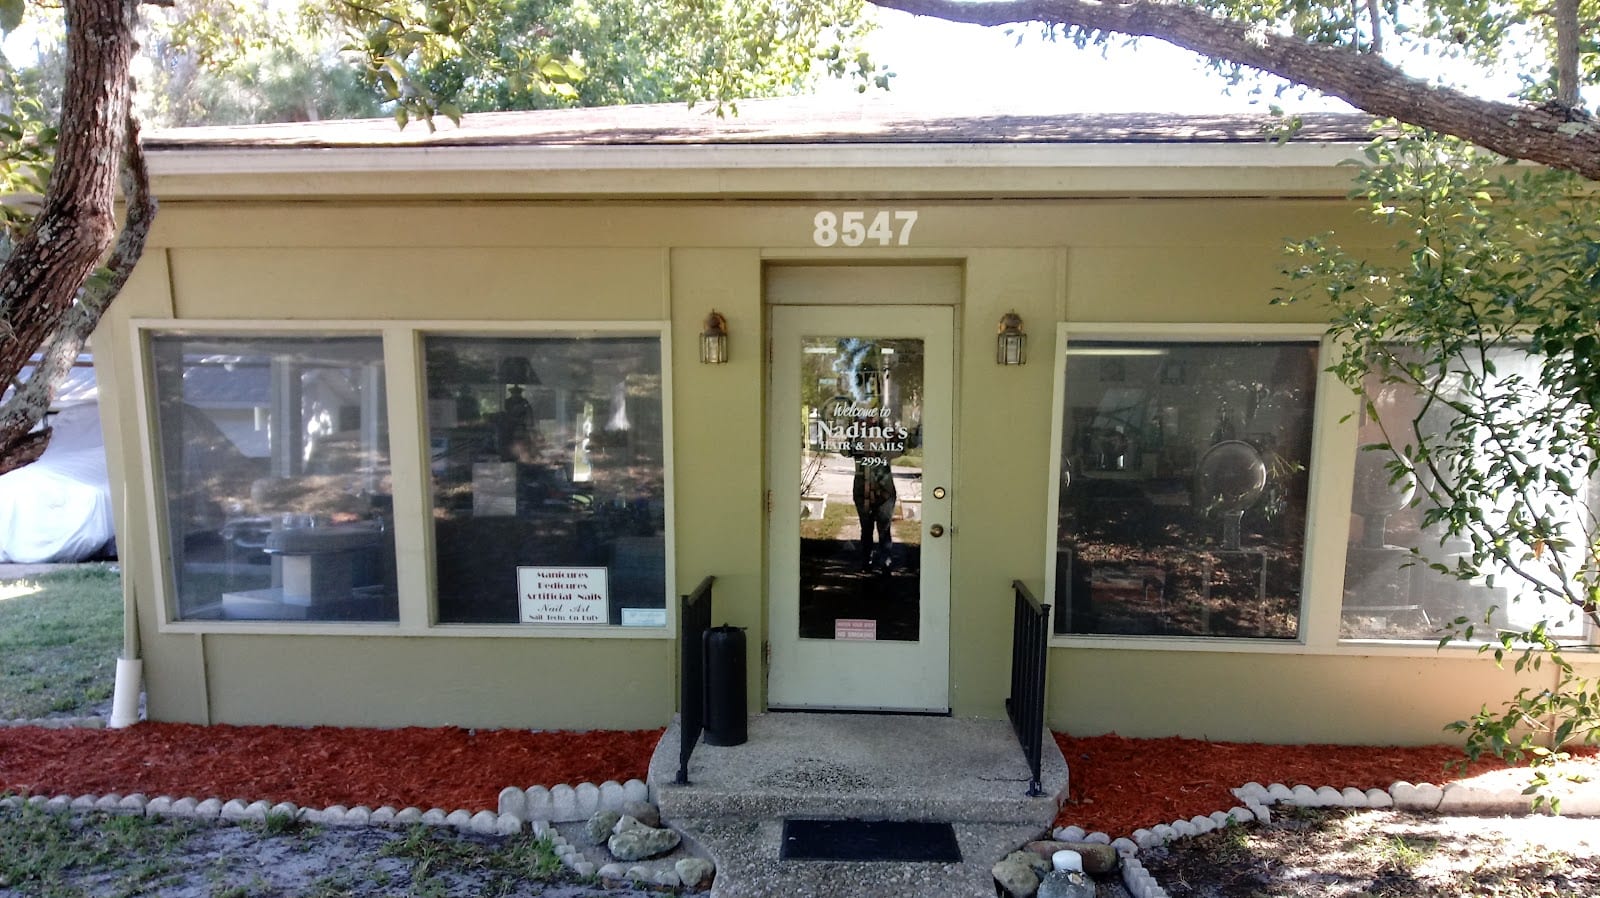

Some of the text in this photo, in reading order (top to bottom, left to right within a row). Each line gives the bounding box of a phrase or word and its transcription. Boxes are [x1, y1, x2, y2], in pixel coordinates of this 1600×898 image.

[813, 210, 918, 247] 8547
[833, 401, 891, 417] Welcome to
[816, 420, 909, 440] Nadine's
[820, 440, 904, 451] HAIR & NAILS
[537, 571, 588, 579] Manicures
[538, 581, 588, 589] Pedicures
[527, 592, 602, 600] Artificial Nails
[537, 602, 591, 612] Nail Art
